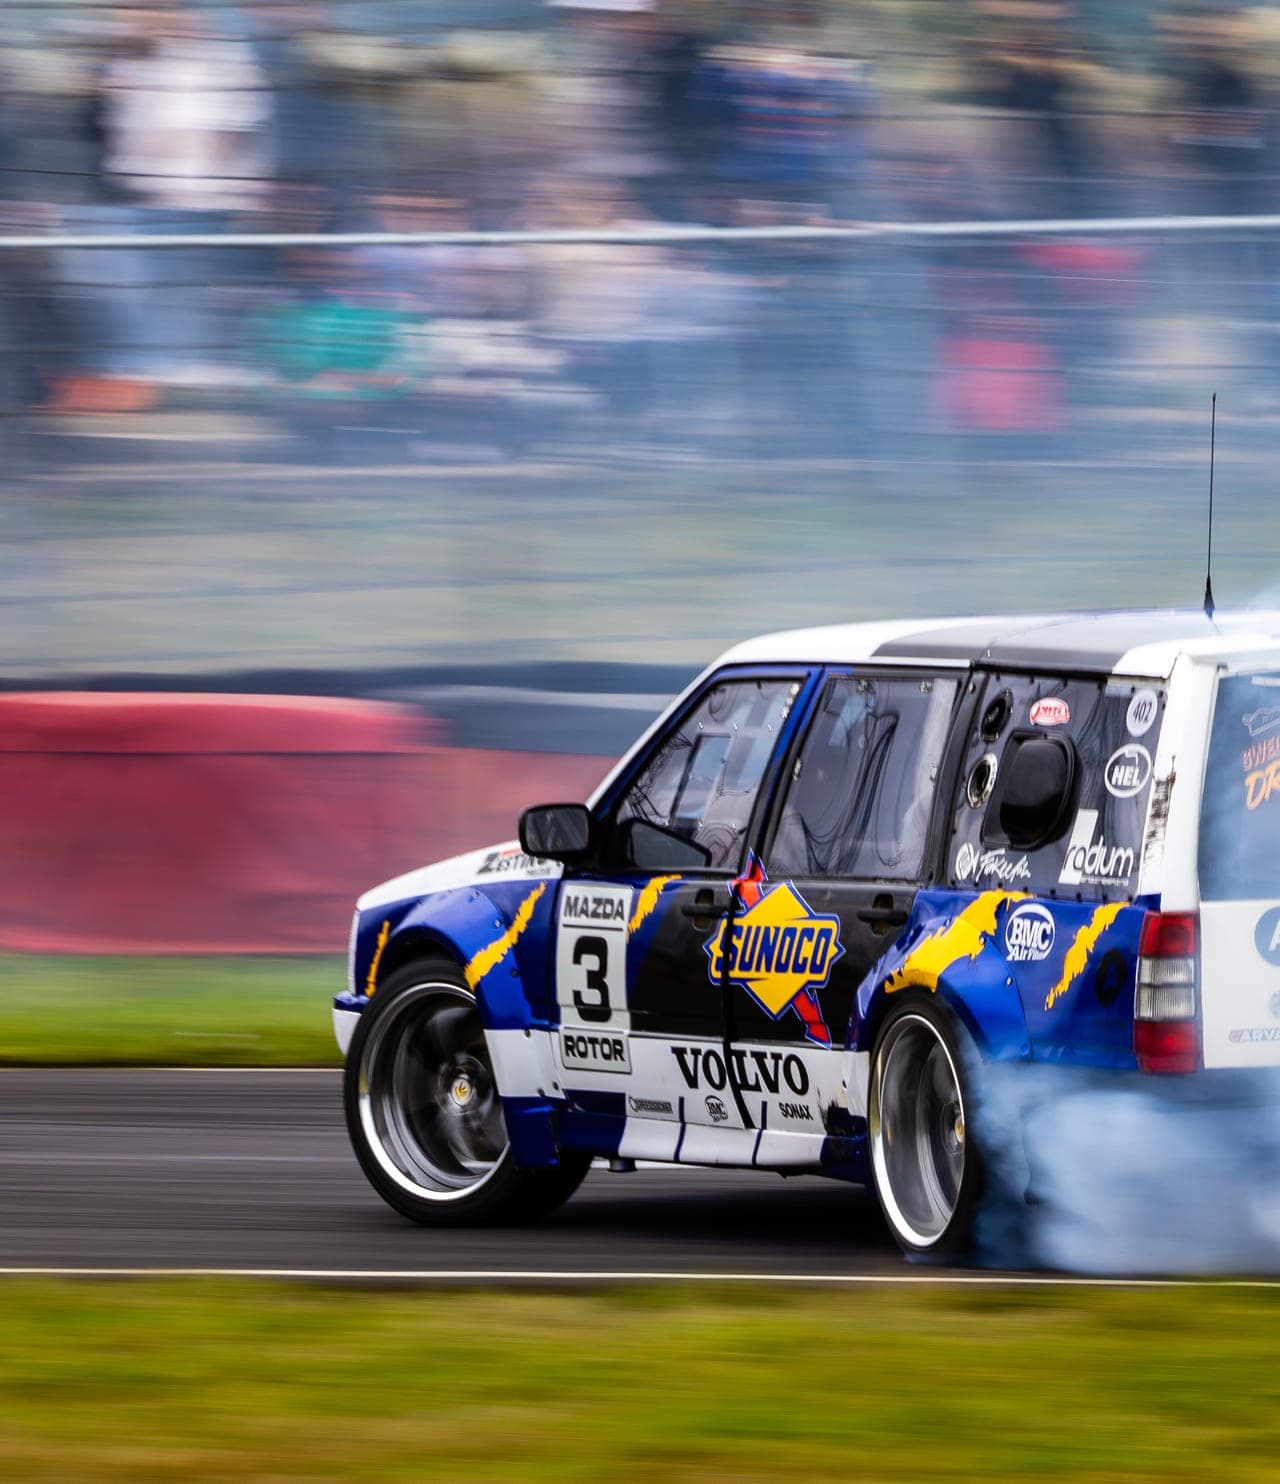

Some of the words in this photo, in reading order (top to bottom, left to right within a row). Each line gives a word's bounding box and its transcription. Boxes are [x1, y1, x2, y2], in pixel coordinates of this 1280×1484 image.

[1133, 700, 1154, 724] 402
[1110, 764, 1140, 786] HEL
[563, 896, 625, 921] MAZDA
[1010, 917, 1051, 951] BMC
[717, 924, 829, 975] SUNOCO
[572, 935, 613, 1023] 3
[564, 1035, 626, 1062] ROTOR
[671, 1046, 810, 1096] VOLVO
[779, 1102, 814, 1120] SONAX
